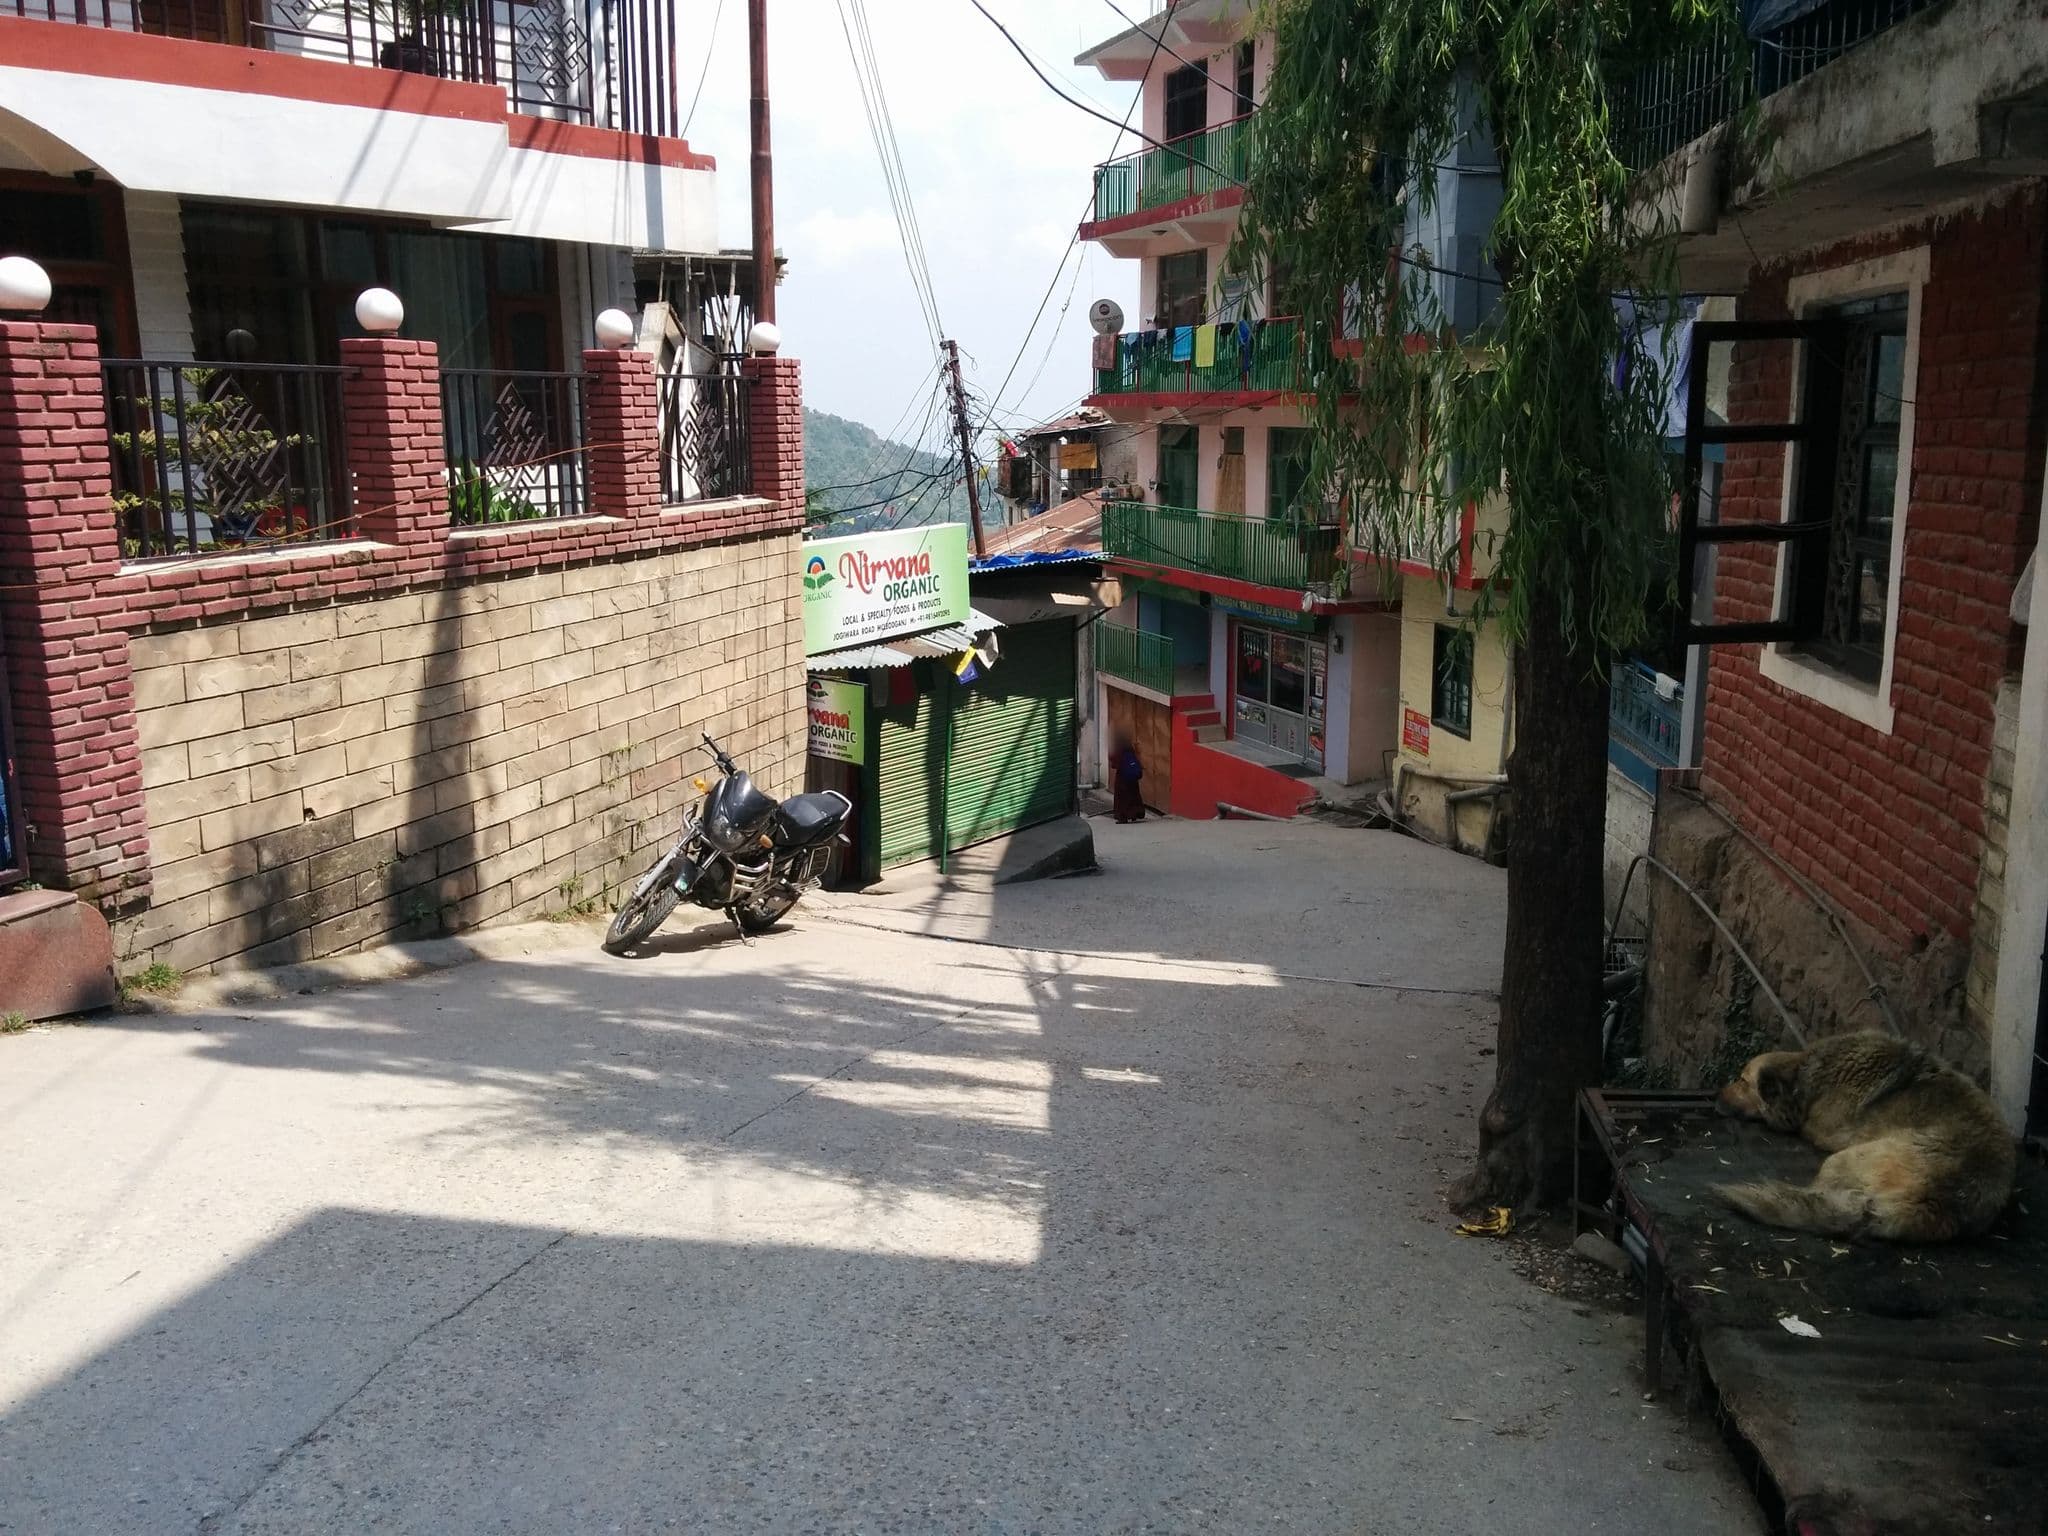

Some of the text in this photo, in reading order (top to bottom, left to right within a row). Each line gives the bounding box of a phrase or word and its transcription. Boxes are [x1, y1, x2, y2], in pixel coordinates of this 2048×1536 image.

[839, 551, 931, 594] Nirvana
[883, 575, 940, 601] ORGANIC
[842, 598, 942, 626] LOCAL & SPECIALTY FOODS & PRODUCTS
[833, 629, 860, 641] JOGIWARA
[861, 626, 875, 636] ROAD
[810, 709, 850, 730] vana
[810, 725, 857, 744] ORGANIC
